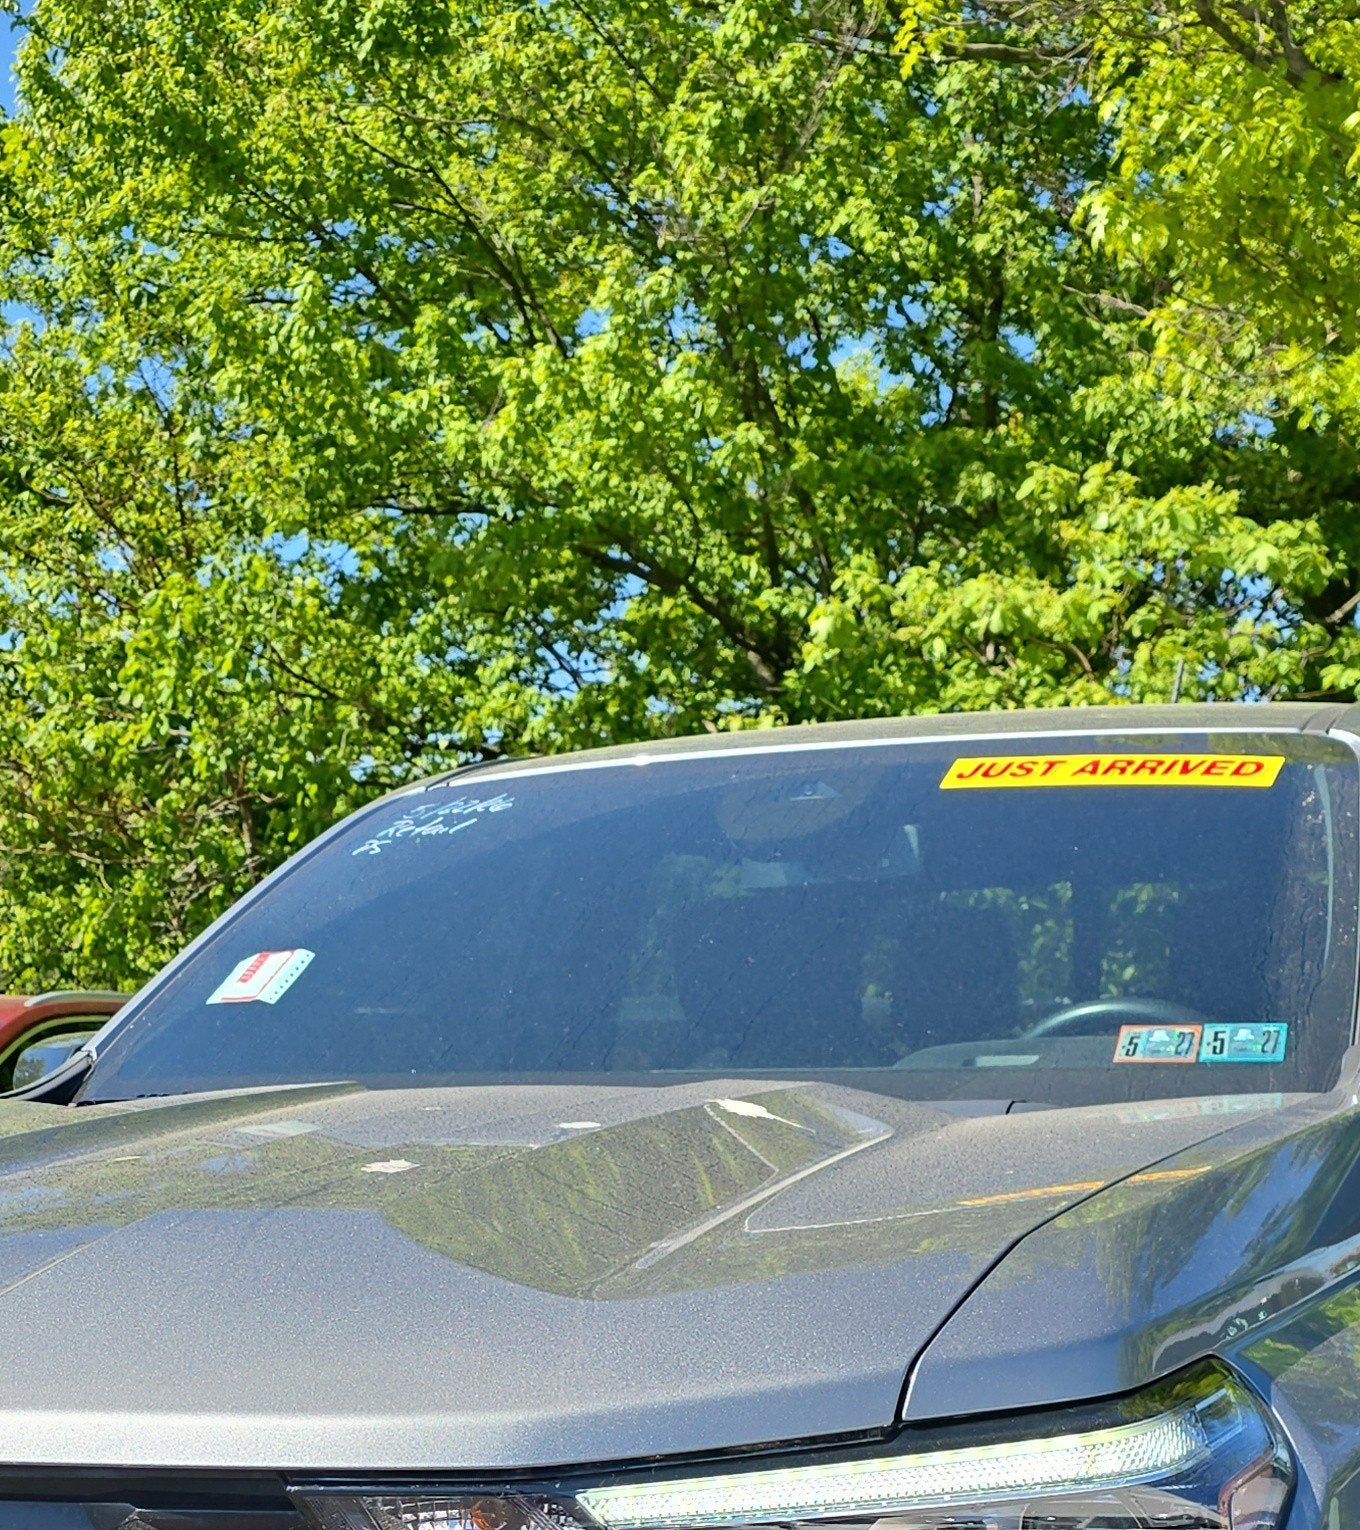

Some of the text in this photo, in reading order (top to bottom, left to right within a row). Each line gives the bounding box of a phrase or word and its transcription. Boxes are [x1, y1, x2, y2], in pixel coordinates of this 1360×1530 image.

[956, 759, 1265, 779] JUST ARRIVED
[1125, 1031, 1196, 1057] 5 27
[1211, 1029, 1281, 1056] 5 27
